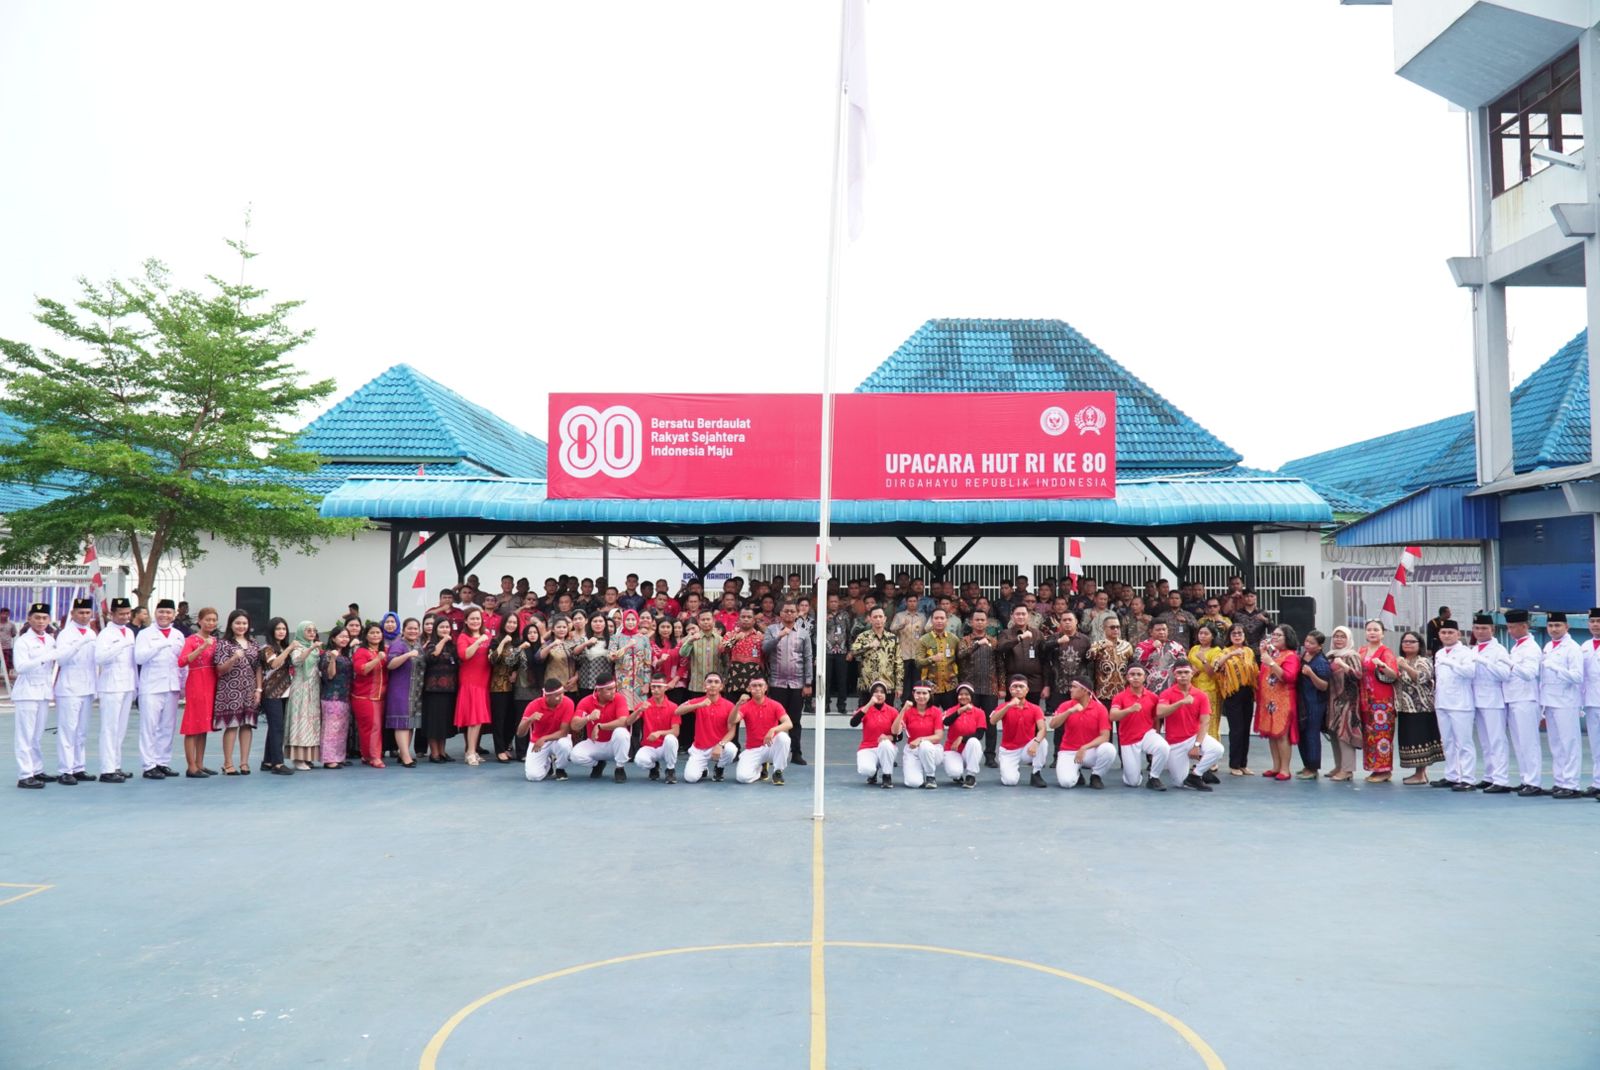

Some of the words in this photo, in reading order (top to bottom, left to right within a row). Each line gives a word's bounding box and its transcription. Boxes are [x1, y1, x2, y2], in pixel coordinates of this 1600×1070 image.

[650, 417, 695, 429] Bersatu
[696, 417, 751, 429] Berdaulat
[559, 405, 643, 479] 80
[650, 431, 690, 444] Rakyat
[691, 431, 746, 444] Sejahtera
[651, 445, 706, 457] Indonesia
[707, 445, 733, 459] Maju
[886, 453, 974, 474] UPACARA
[982, 453, 1020, 473] HUT
[1026, 453, 1045, 473] RI
[1053, 453, 1077, 473] KE
[1083, 452, 1106, 473] 80
[886, 478, 958, 488] DIRGAHAYU
[966, 478, 1030, 488] REPUBLIK
[1037, 477, 1107, 488] INDONESIA
